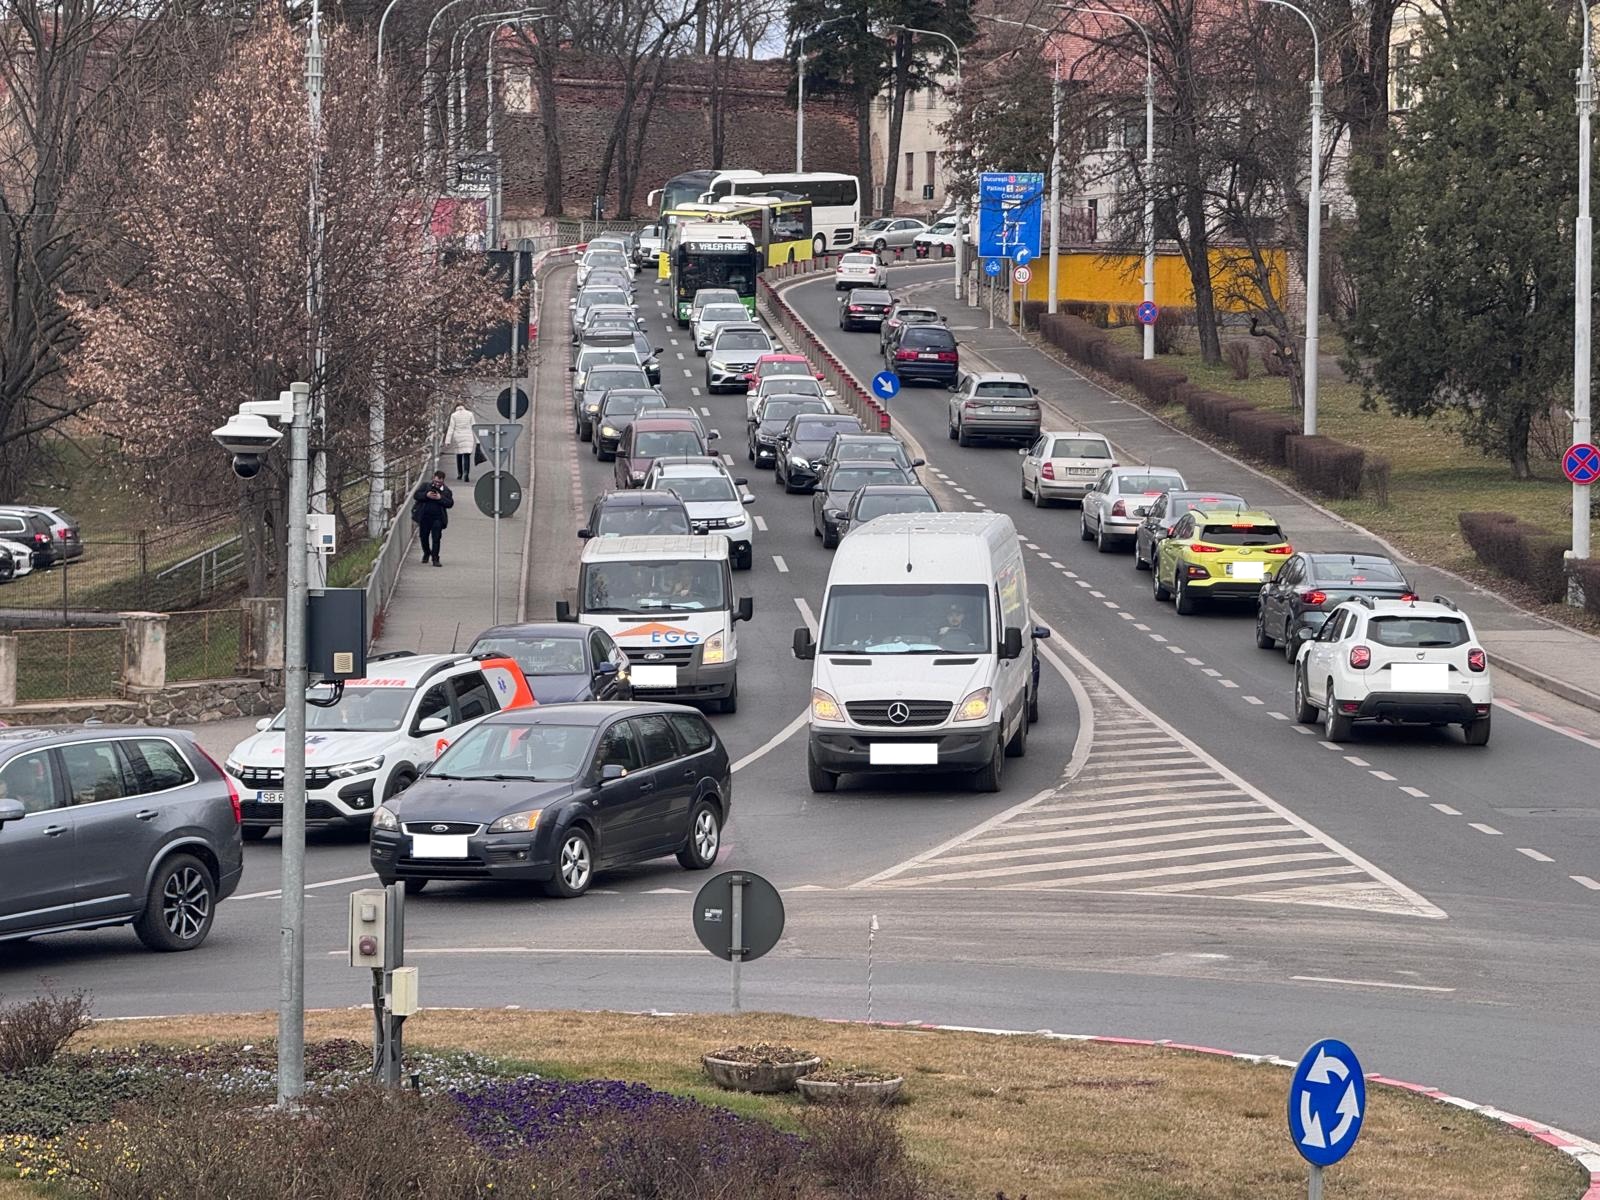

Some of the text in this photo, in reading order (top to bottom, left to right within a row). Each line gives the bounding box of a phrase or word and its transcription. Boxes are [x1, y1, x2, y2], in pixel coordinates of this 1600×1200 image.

[699, 242, 723, 250] VALEA
[1016, 270, 1027, 280] 30
[652, 630, 699, 643] EGG
[263, 792, 275, 802] SB
